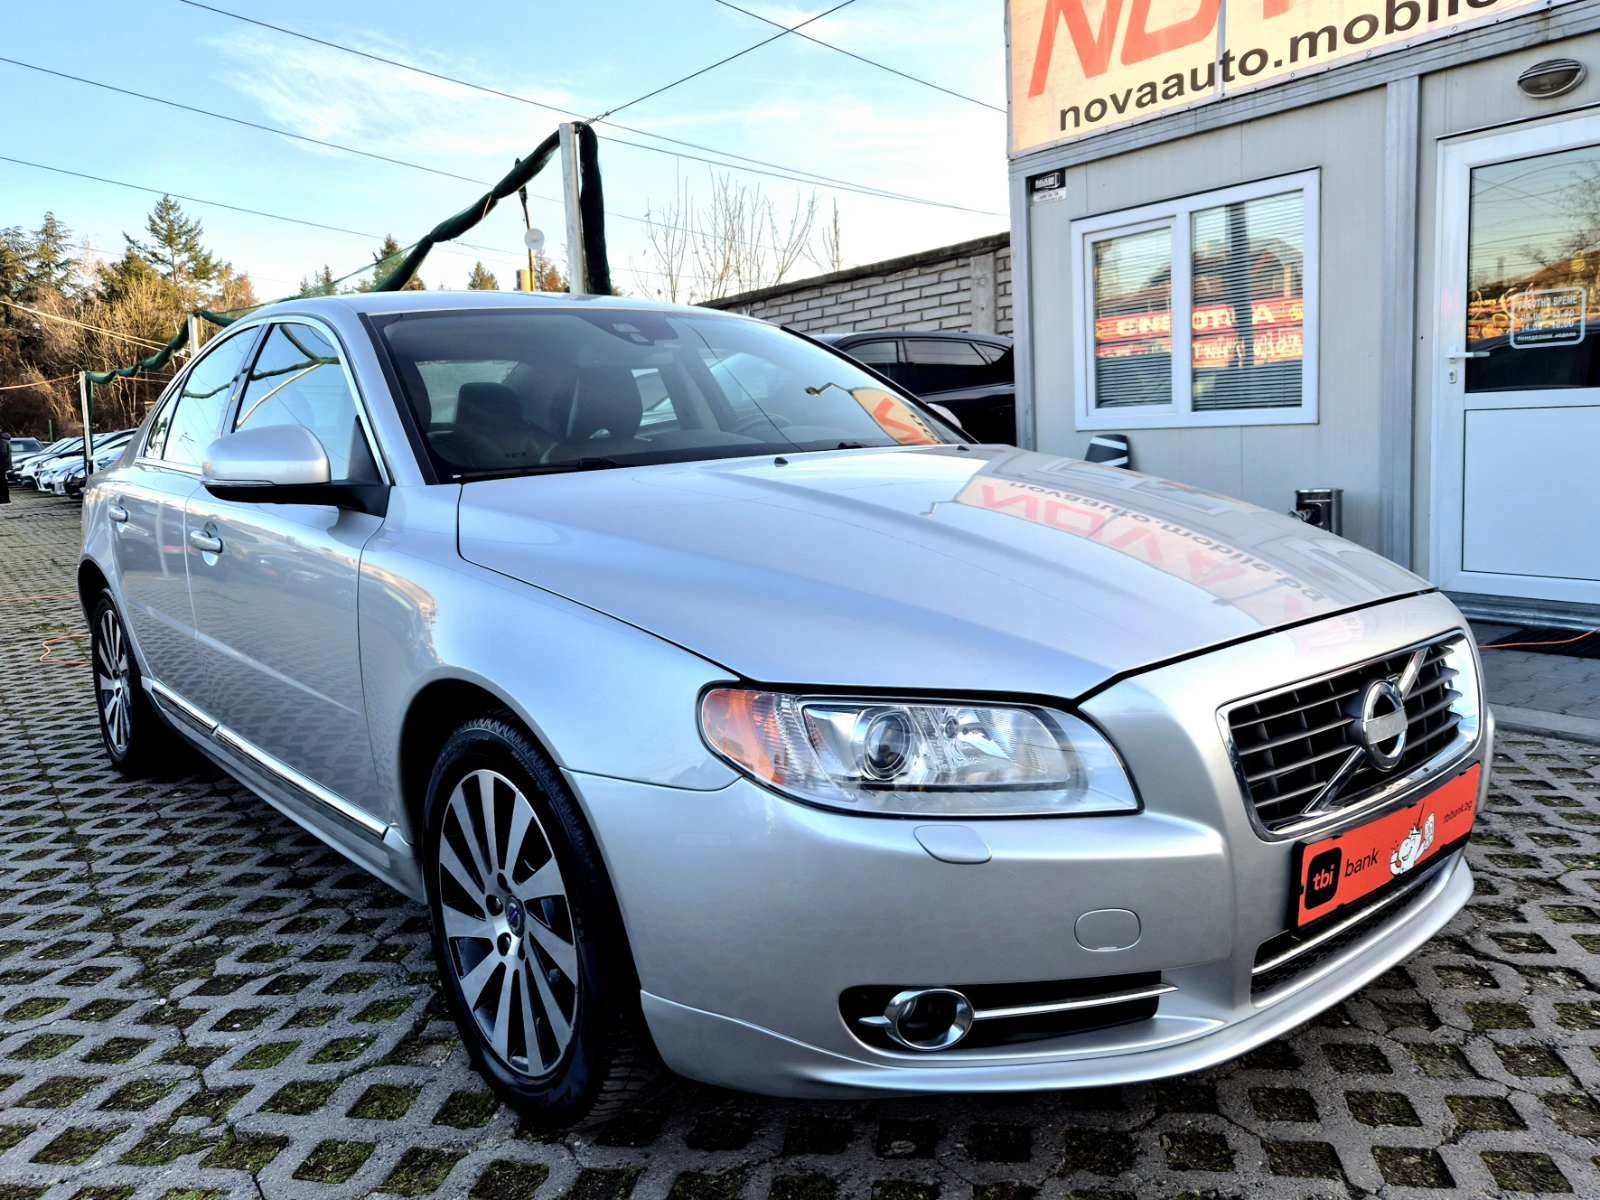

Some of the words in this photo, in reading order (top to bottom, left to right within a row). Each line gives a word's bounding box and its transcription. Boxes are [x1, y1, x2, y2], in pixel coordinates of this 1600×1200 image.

[1058, 0, 1499, 131] novaauto.mobi
[1313, 864, 1335, 890] tbi
[1345, 847, 1380, 877] bank
